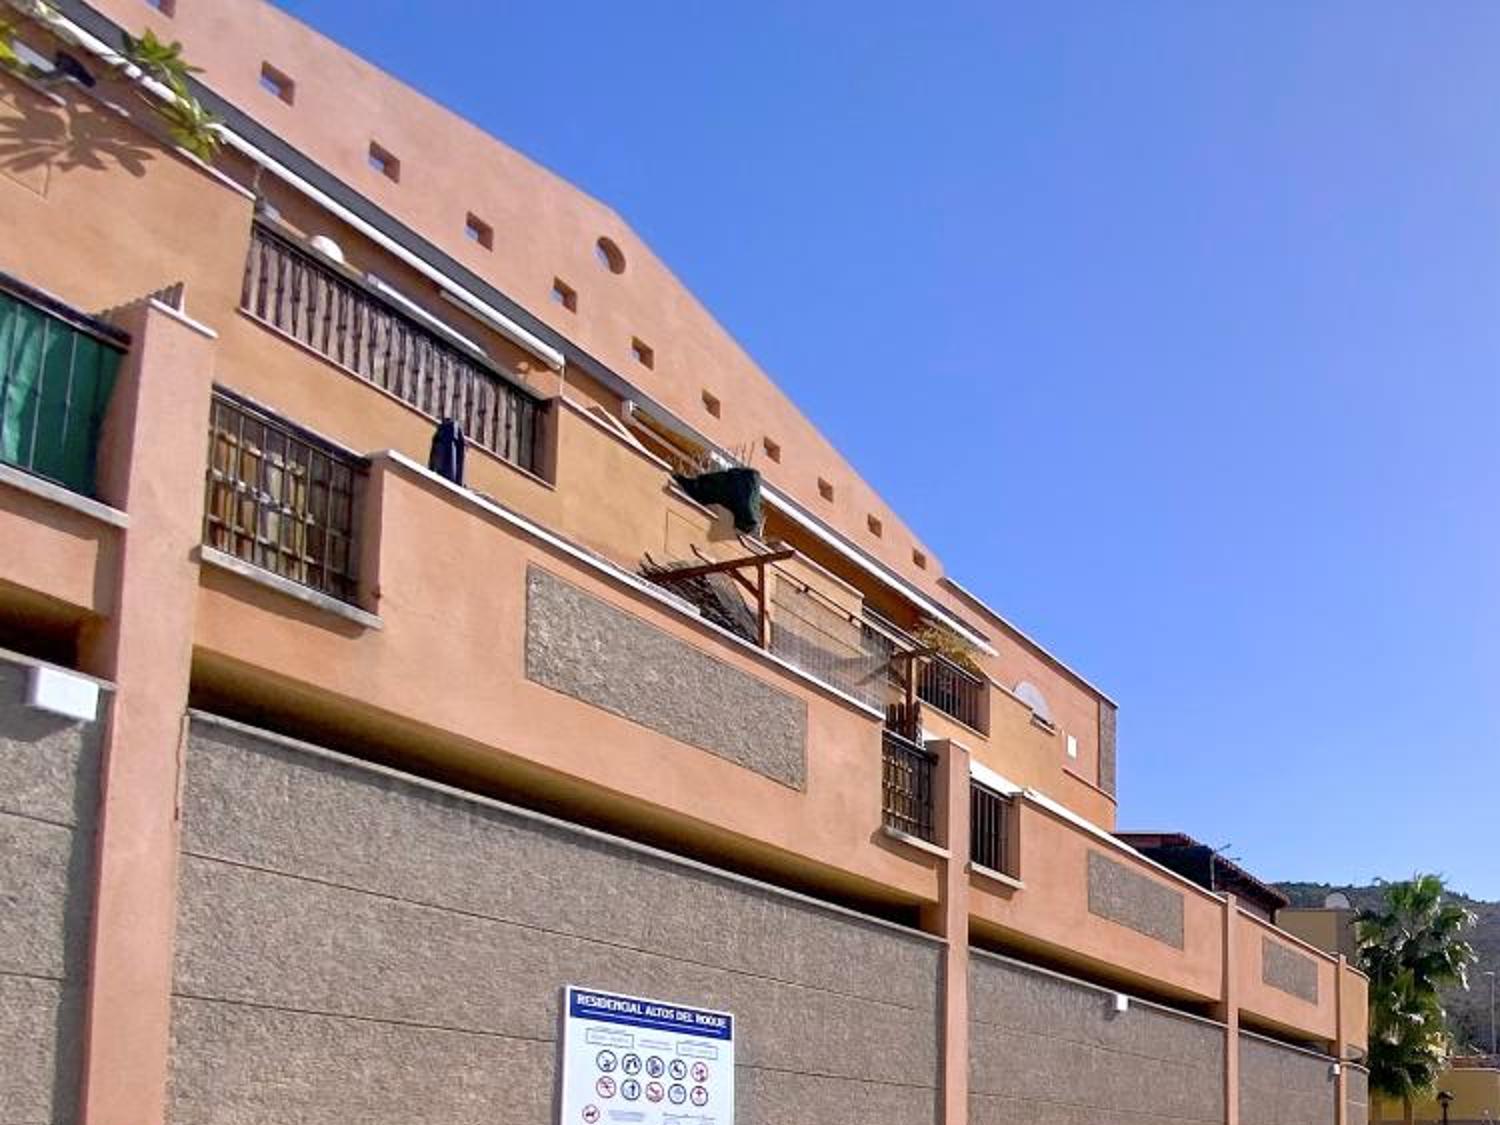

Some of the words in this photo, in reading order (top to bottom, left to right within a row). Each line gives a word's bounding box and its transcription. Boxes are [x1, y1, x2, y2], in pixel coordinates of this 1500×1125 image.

[577, 994, 642, 1014] RESIDENCIAL
[645, 1006, 674, 1019] ALTOS
[676, 1012, 693, 1022] DEL
